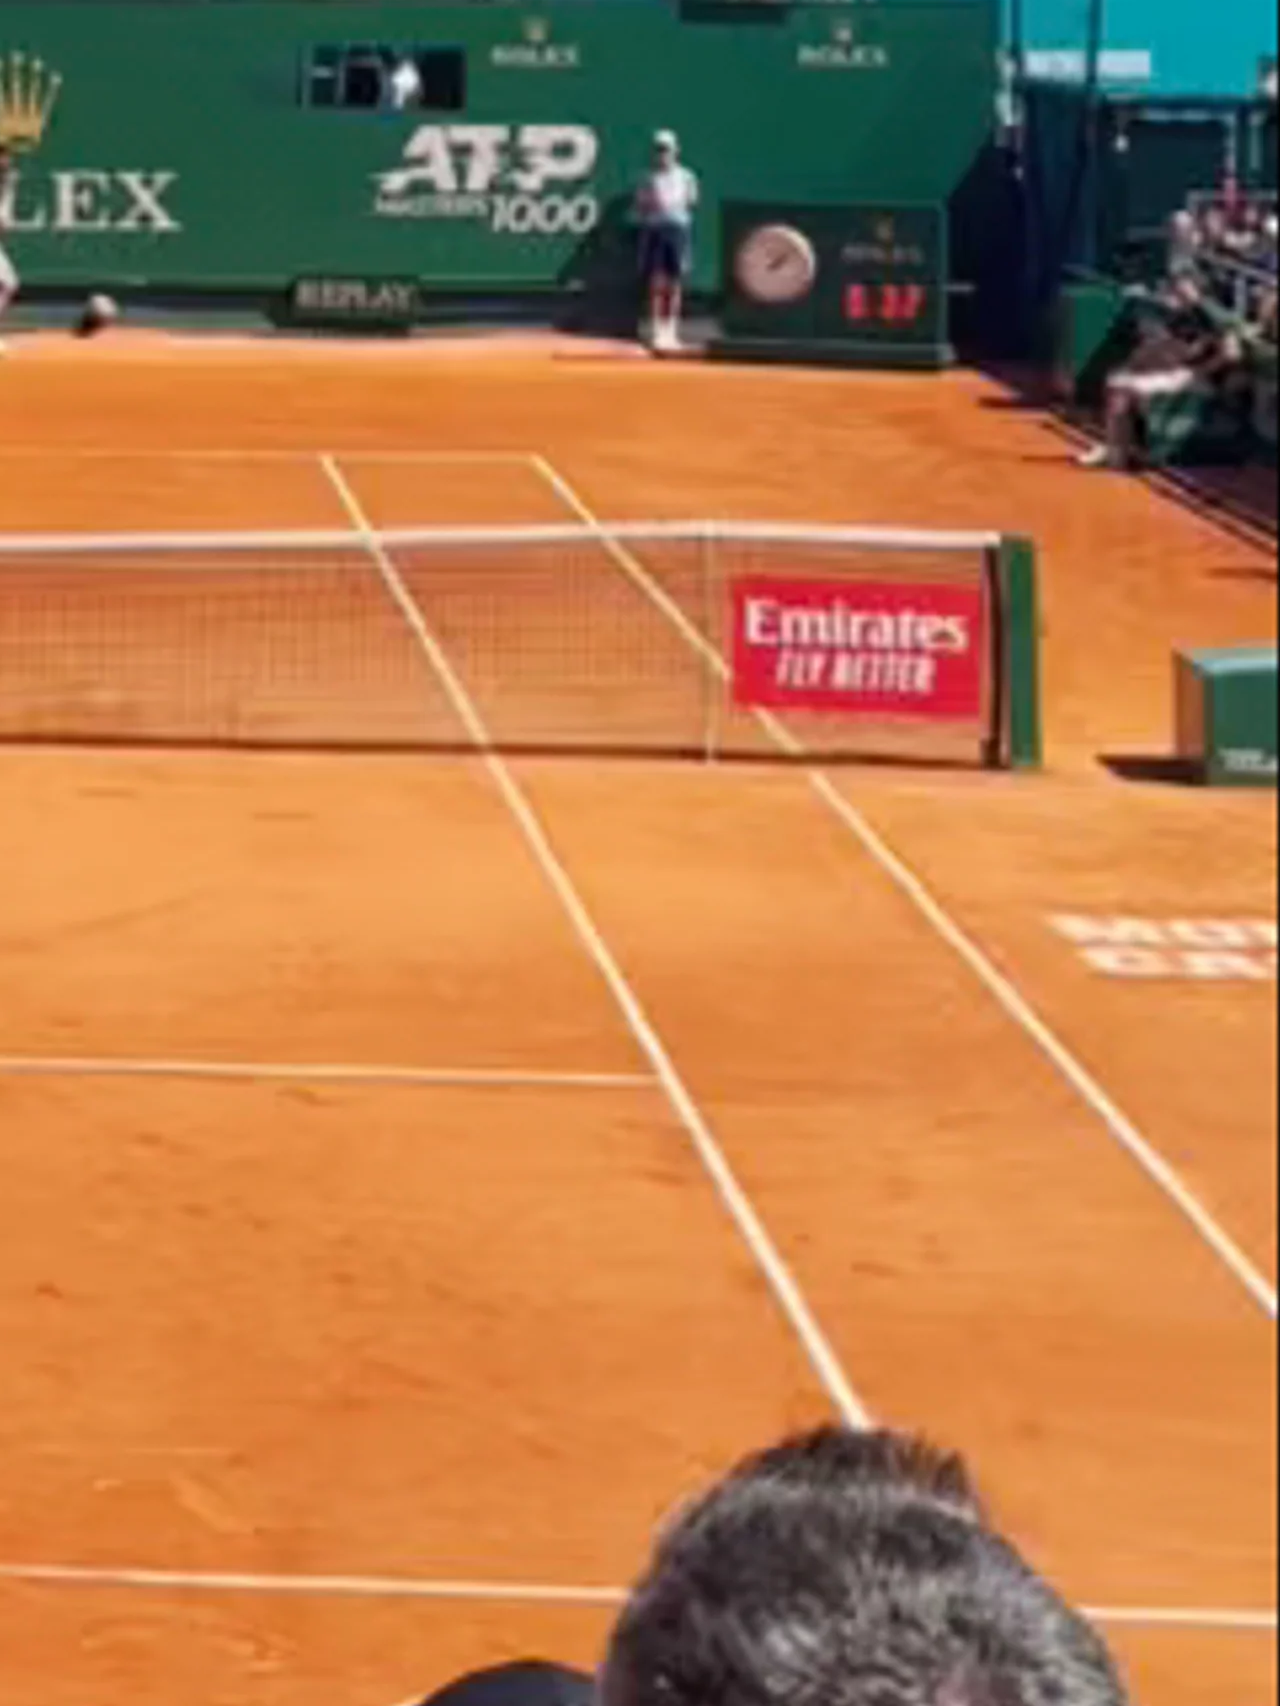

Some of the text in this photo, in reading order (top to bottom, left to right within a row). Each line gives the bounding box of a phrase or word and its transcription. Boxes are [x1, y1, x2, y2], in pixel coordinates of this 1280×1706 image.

[490, 43, 578, 67] ROLEX
[796, 43, 886, 67] ROLEX
[365, 122, 600, 193] ATP
[488, 194, 600, 234] 1000
[296, 283, 416, 310] REPLAY
[743, 597, 968, 650] Emirates
[776, 652, 938, 696] FLY BETTER
